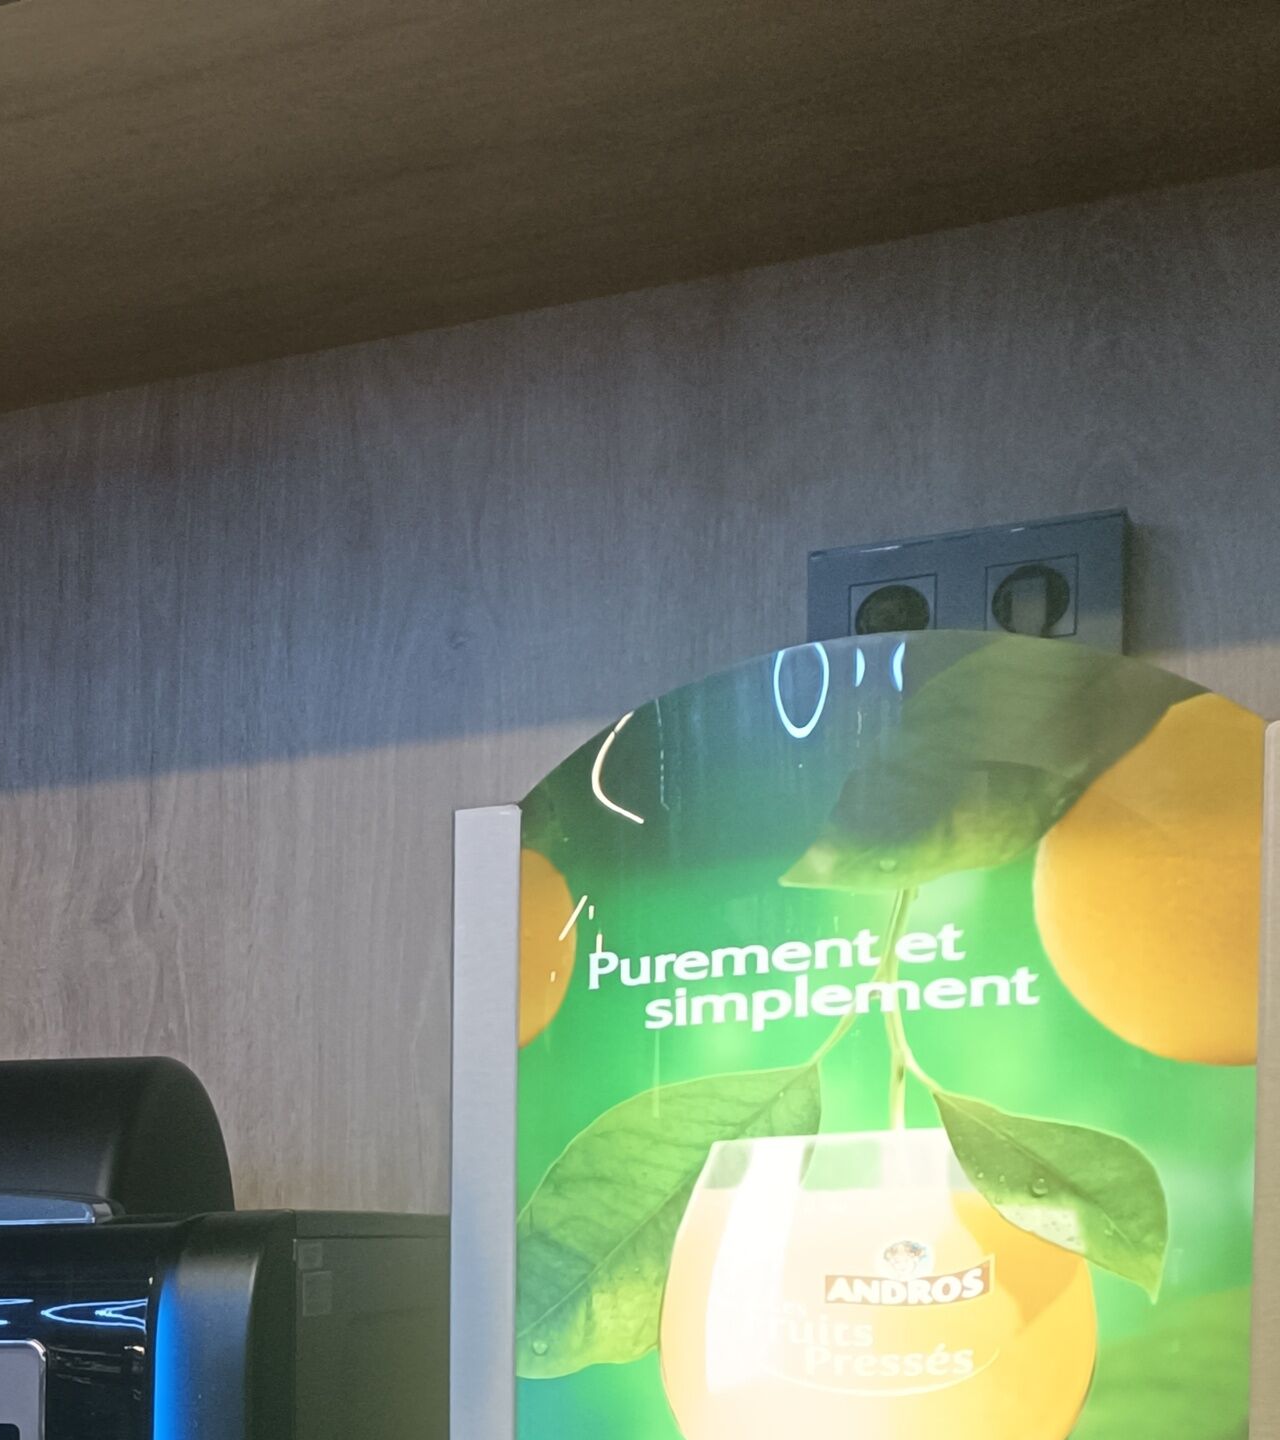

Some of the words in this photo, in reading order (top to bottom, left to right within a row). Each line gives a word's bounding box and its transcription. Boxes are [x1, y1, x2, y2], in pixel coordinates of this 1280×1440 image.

[588, 928, 880, 990] Purement
[894, 923, 966, 963] et
[645, 966, 1040, 1031] simplement
[826, 1267, 984, 1305] ANDROS
[804, 1342, 974, 1377] Pressés
